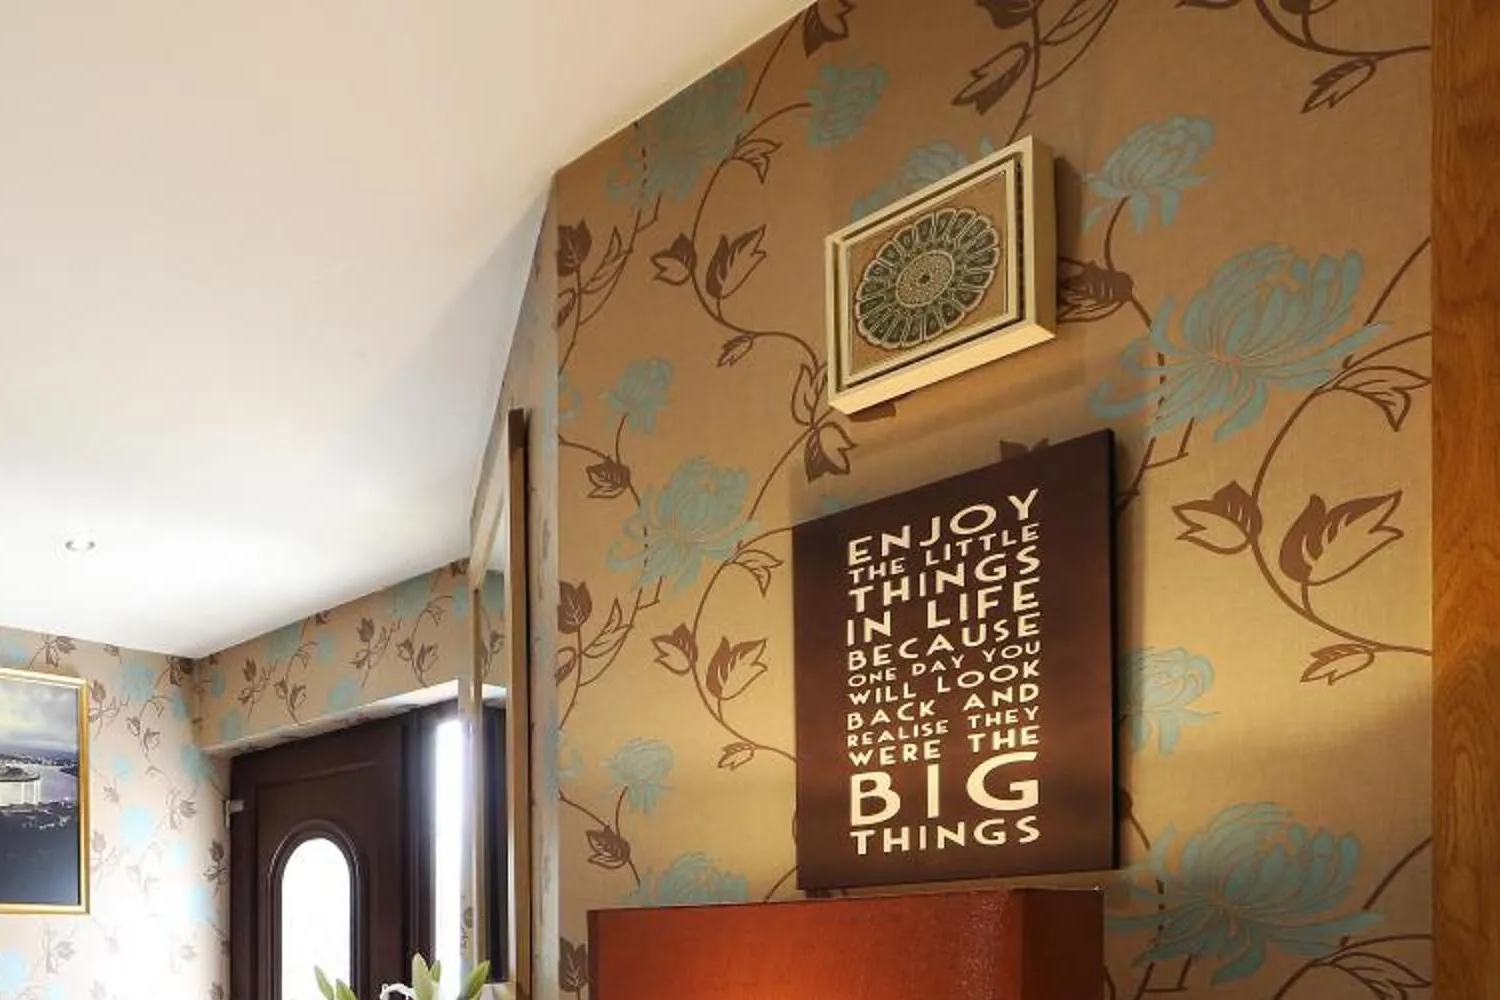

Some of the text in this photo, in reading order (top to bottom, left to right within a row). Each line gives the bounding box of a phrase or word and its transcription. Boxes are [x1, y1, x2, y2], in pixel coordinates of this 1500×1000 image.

[848, 488, 1038, 566] ENJOY
[848, 523, 1039, 584] THE LITTLE
[848, 545, 1040, 612] THINGS
[847, 577, 1040, 646] IN LIFE
[848, 612, 1040, 671] BECAUSE
[848, 641, 1040, 687] ONE DAY YOU
[847, 683, 1039, 731] BACK AND
[848, 659, 1040, 705] WILL LOOK
[847, 706, 1039, 748] REALISE THEY
[848, 725, 1040, 767] WERE THE
[850, 751, 1039, 826] BIG
[850, 816, 1040, 855] THINGS
